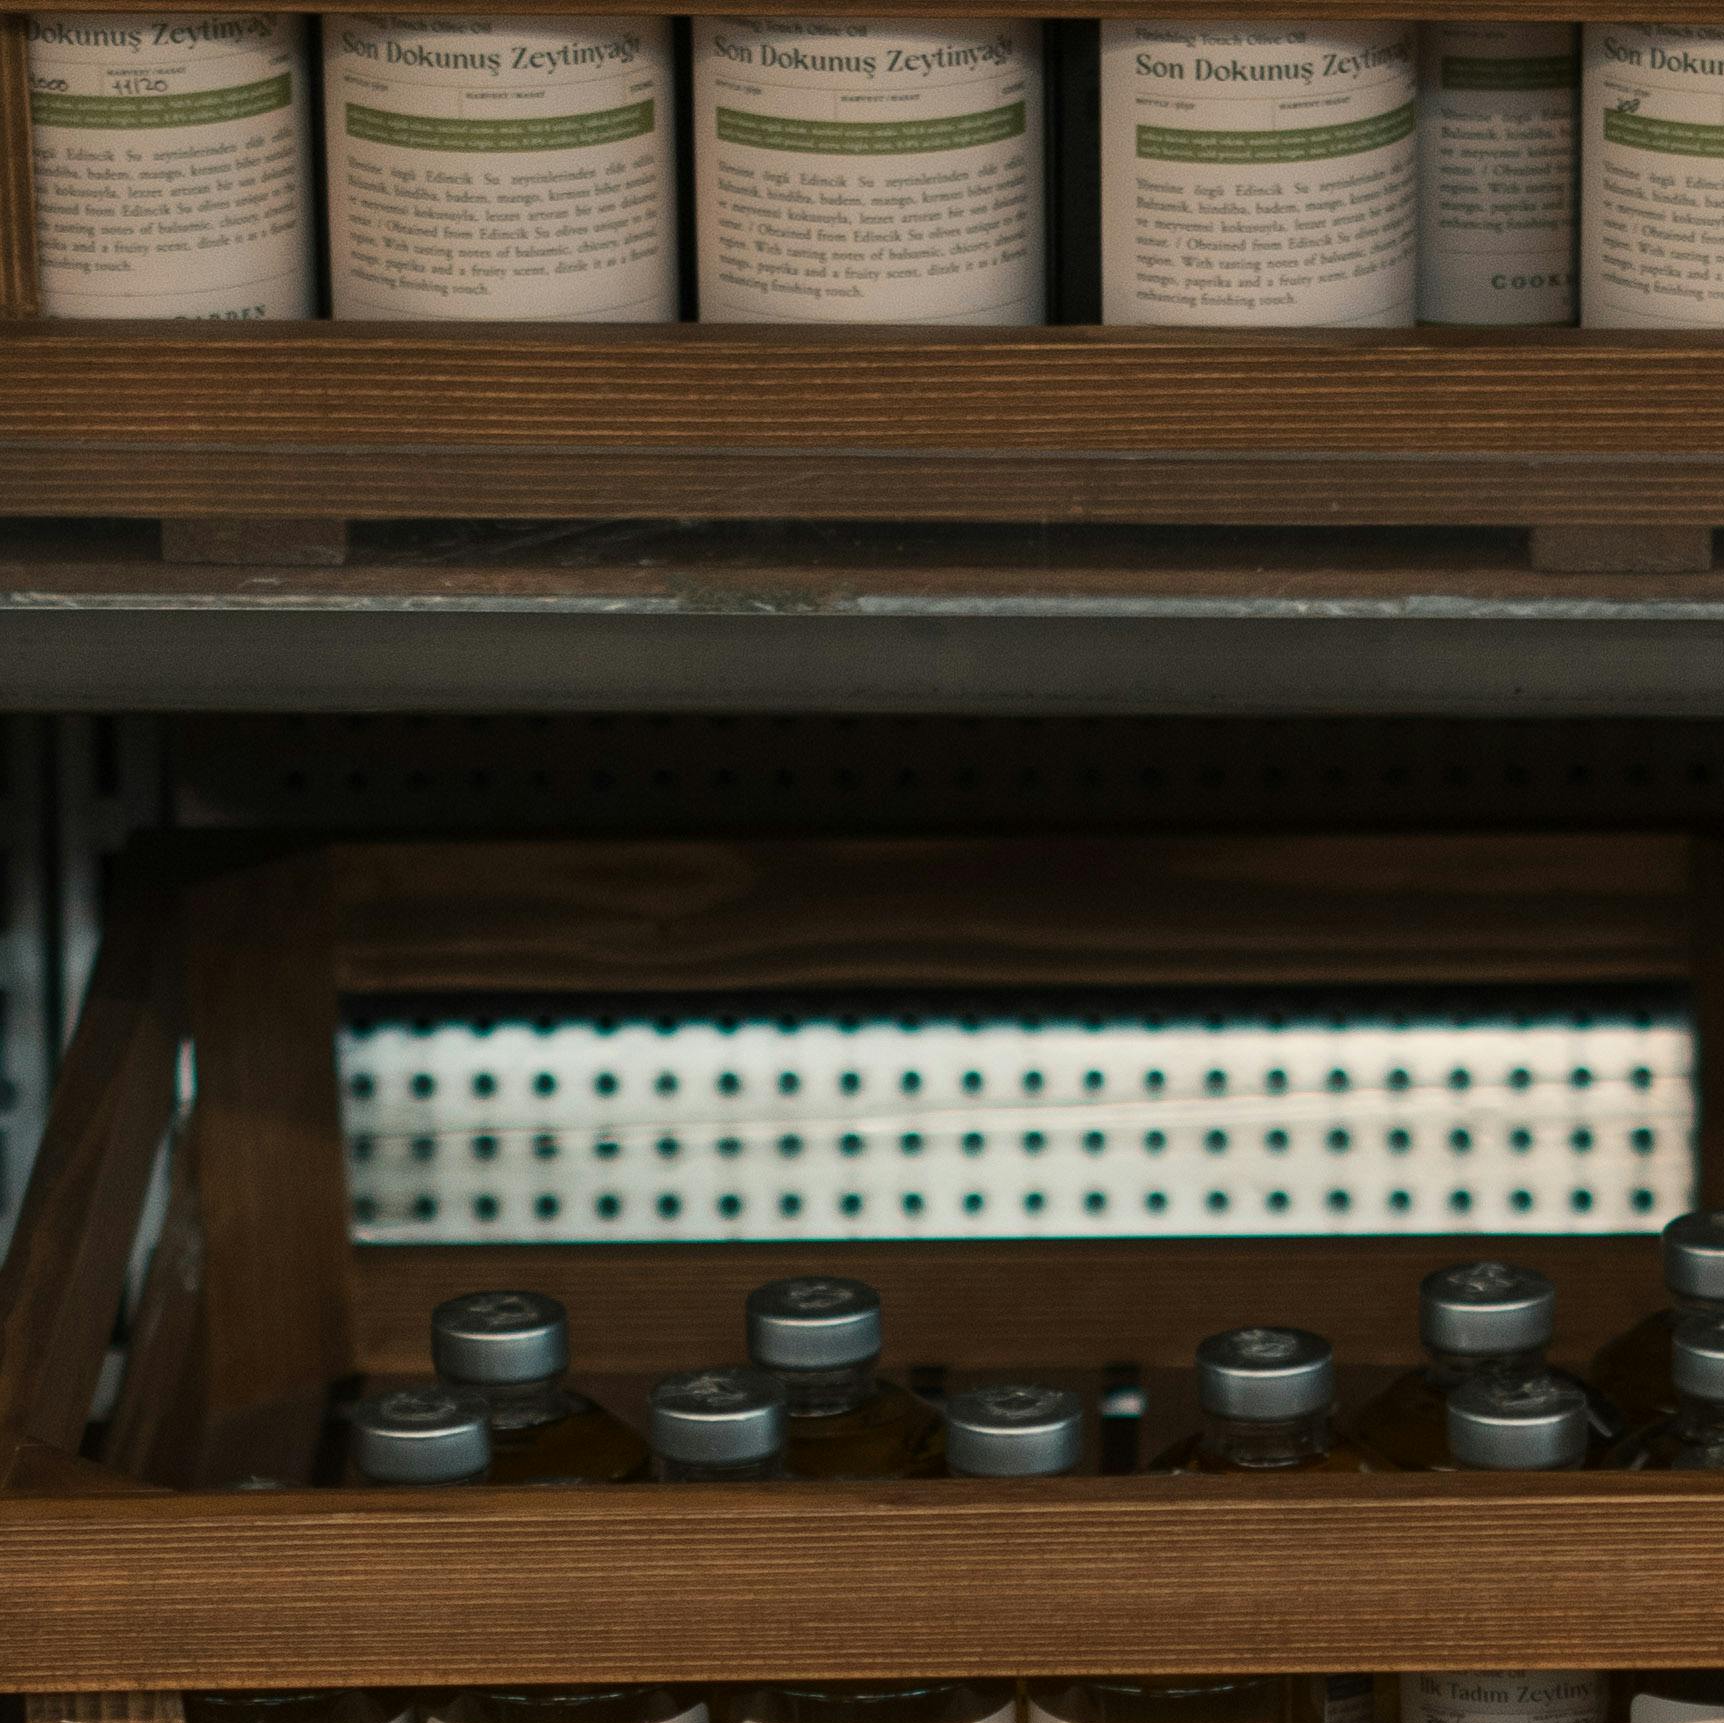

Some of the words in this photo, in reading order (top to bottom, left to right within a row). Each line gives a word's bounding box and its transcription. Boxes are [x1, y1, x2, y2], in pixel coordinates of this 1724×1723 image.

[342, 32, 379, 61] Son
[387, 40, 502, 77] Dokunuş
[511, 33, 641, 75] Zeytinyağı
[714, 34, 753, 64] Son
[760, 43, 876, 80] Dokunuş
[886, 36, 1013, 77] Zeytinyağı
[1135, 53, 1185, 80] Son
[1194, 57, 1314, 86] Dokunuş
[1603, 36, 1642, 66] Son
